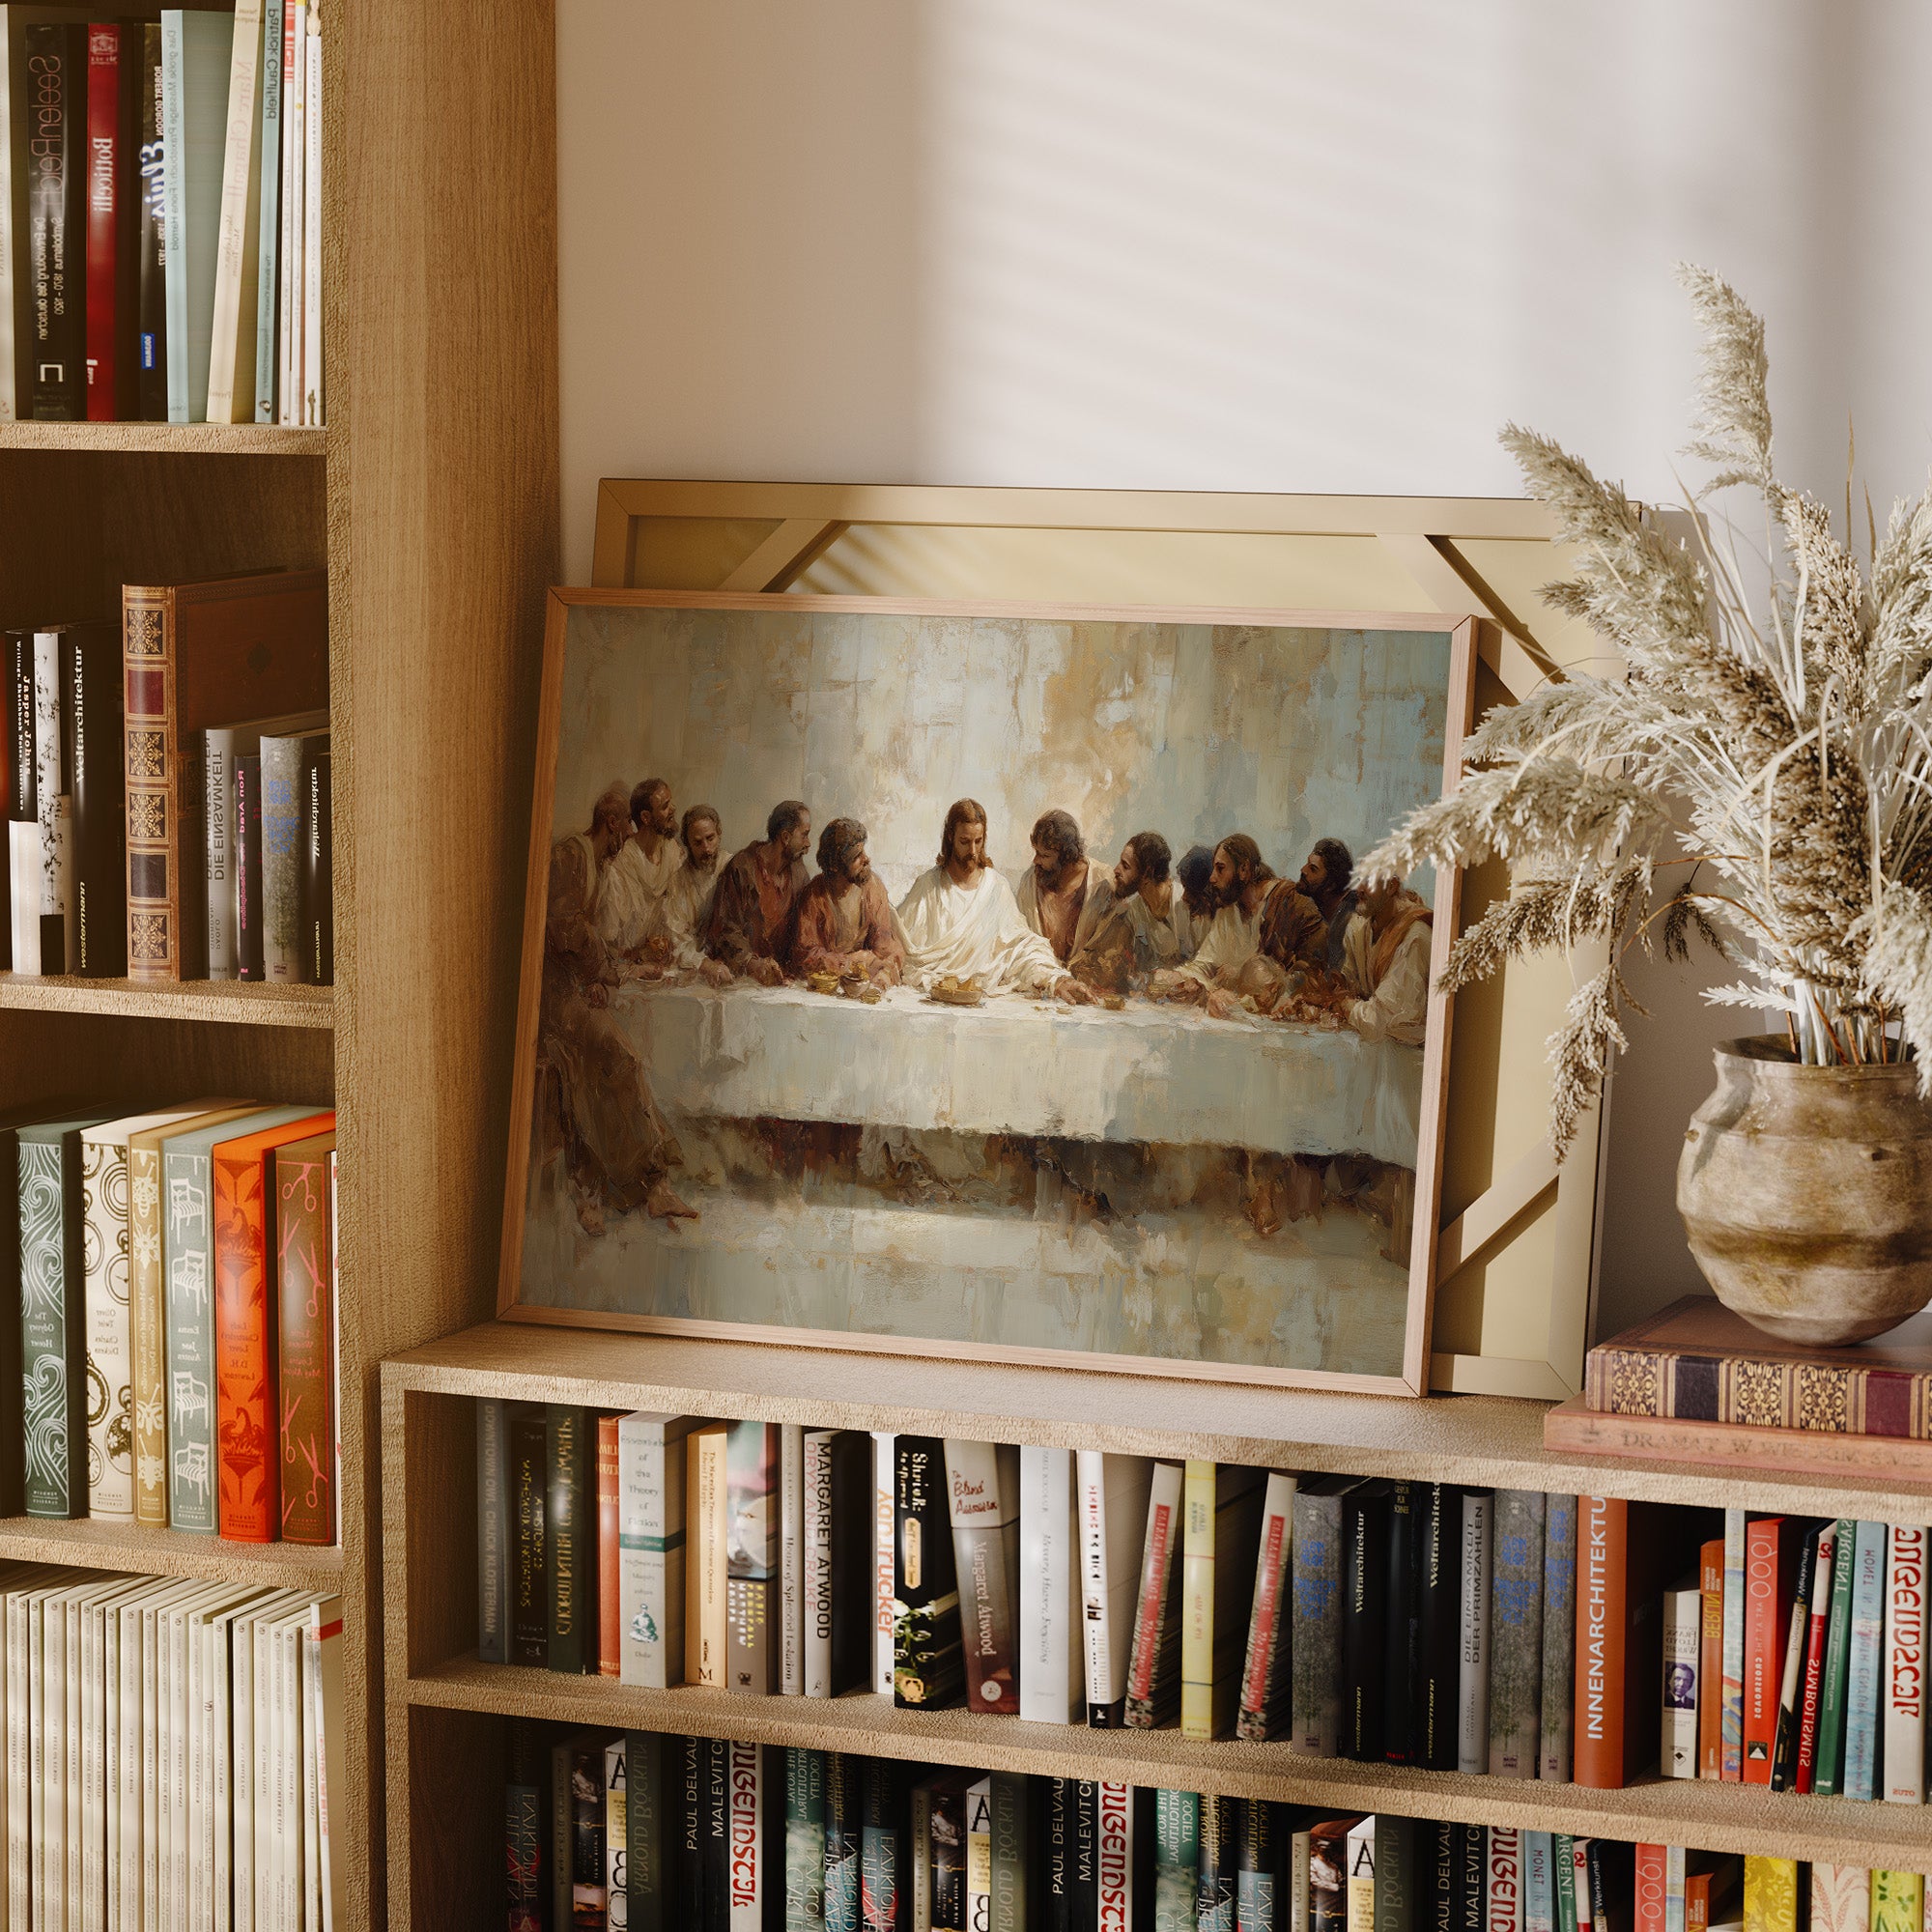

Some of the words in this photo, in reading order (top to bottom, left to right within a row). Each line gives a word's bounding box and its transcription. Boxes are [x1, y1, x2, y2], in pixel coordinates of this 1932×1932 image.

[22, 675, 31, 726] Jasper
[74, 645, 84, 783] Weltarchitektur
[24, 730, 33, 776] Johns
[484, 1406, 497, 1478] DOWNTOWN
[806, 1441, 817, 1491] ORYX
[484, 1478, 497, 1505] OWL
[628, 1485, 659, 1496] Theory
[806, 1498, 817, 1538] AND
[816, 1442, 832, 1551] MARGARET
[485, 1510, 497, 1551] CHUCK
[627, 1517, 659, 1528] Fiction
[805, 1546, 817, 1612] CRAKE
[971, 1541, 989, 1601] Margaret
[1354, 1510, 1365, 1614] Weltarchitektur
[1463, 1522, 1474, 1629] EINSAMKEIT
[1471, 1506, 1484, 1622] PRIMZAHLEN
[485, 1554, 497, 1633] KLOSTERMAN
[816, 1556, 832, 1639] ATWOOD
[1587, 1496, 1606, 1740] INNENARCHITEKTU
[978, 1605, 997, 1657] Atwood
[1463, 1641, 1473, 1663] DIE
[1471, 1627, 1483, 1663] DER
[686, 1736, 697, 1802] DELVAU
[686, 1808, 697, 1851] PAUL
[1052, 1777, 1065, 1845] DELVAU
[1052, 1851, 1065, 1895] PAUL
[1437, 1821, 1451, 1890] DELVAU
[1533, 1849, 1545, 1886] MONET
[1592, 1861, 1603, 1909] Werkkunst
[1636, 1857, 1662, 1919] 1900
